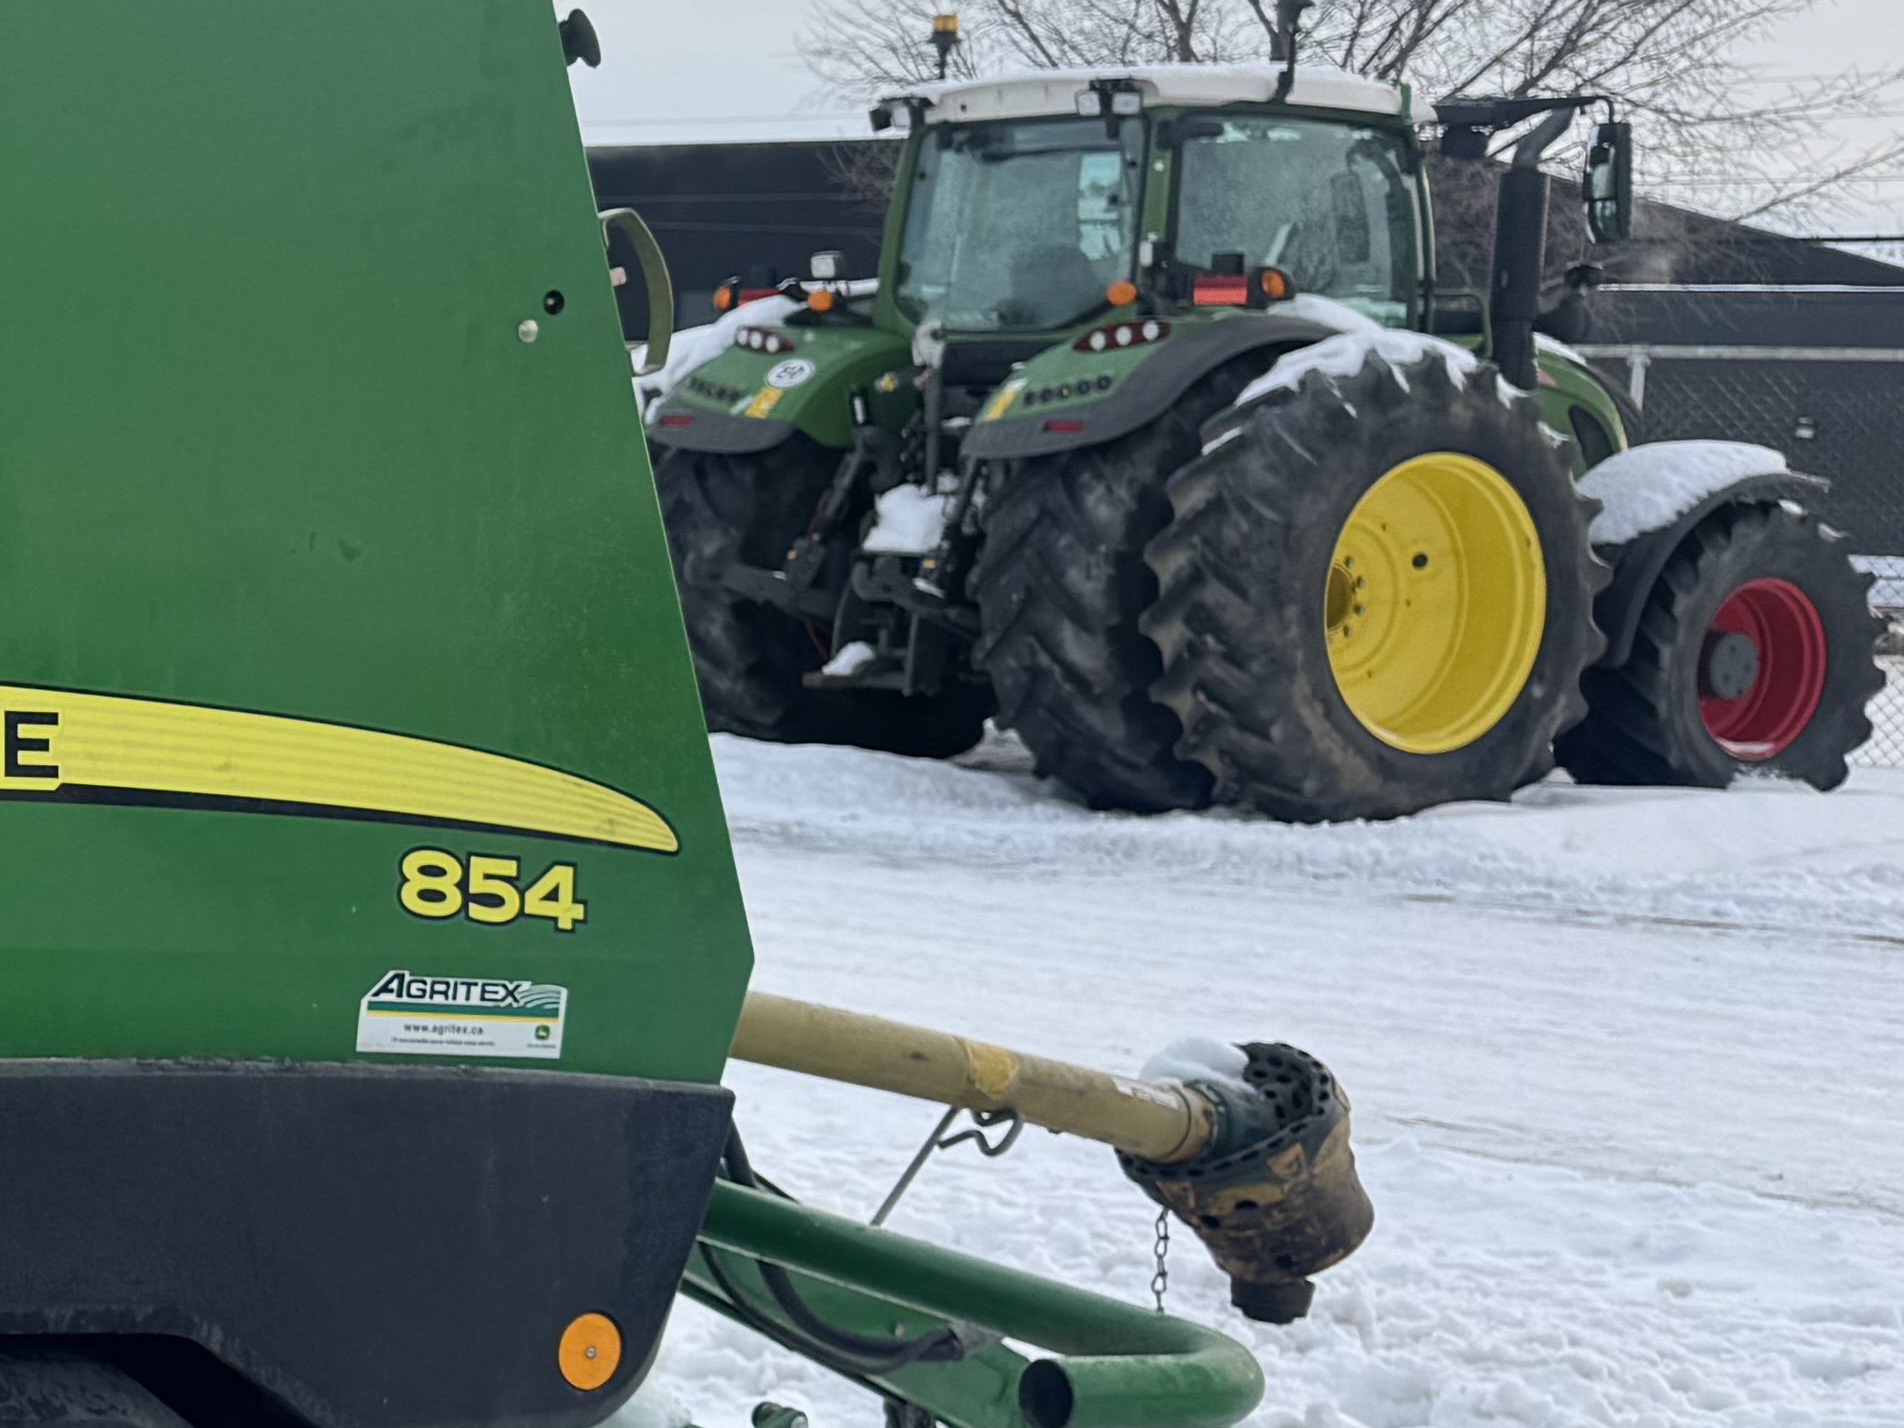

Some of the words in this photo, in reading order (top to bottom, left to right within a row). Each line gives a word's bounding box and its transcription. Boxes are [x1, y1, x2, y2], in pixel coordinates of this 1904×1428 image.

[399, 848, 586, 931] 854
[371, 972, 522, 1004] AGRITEX
[403, 1023, 484, 1037] www.agritex.ca
